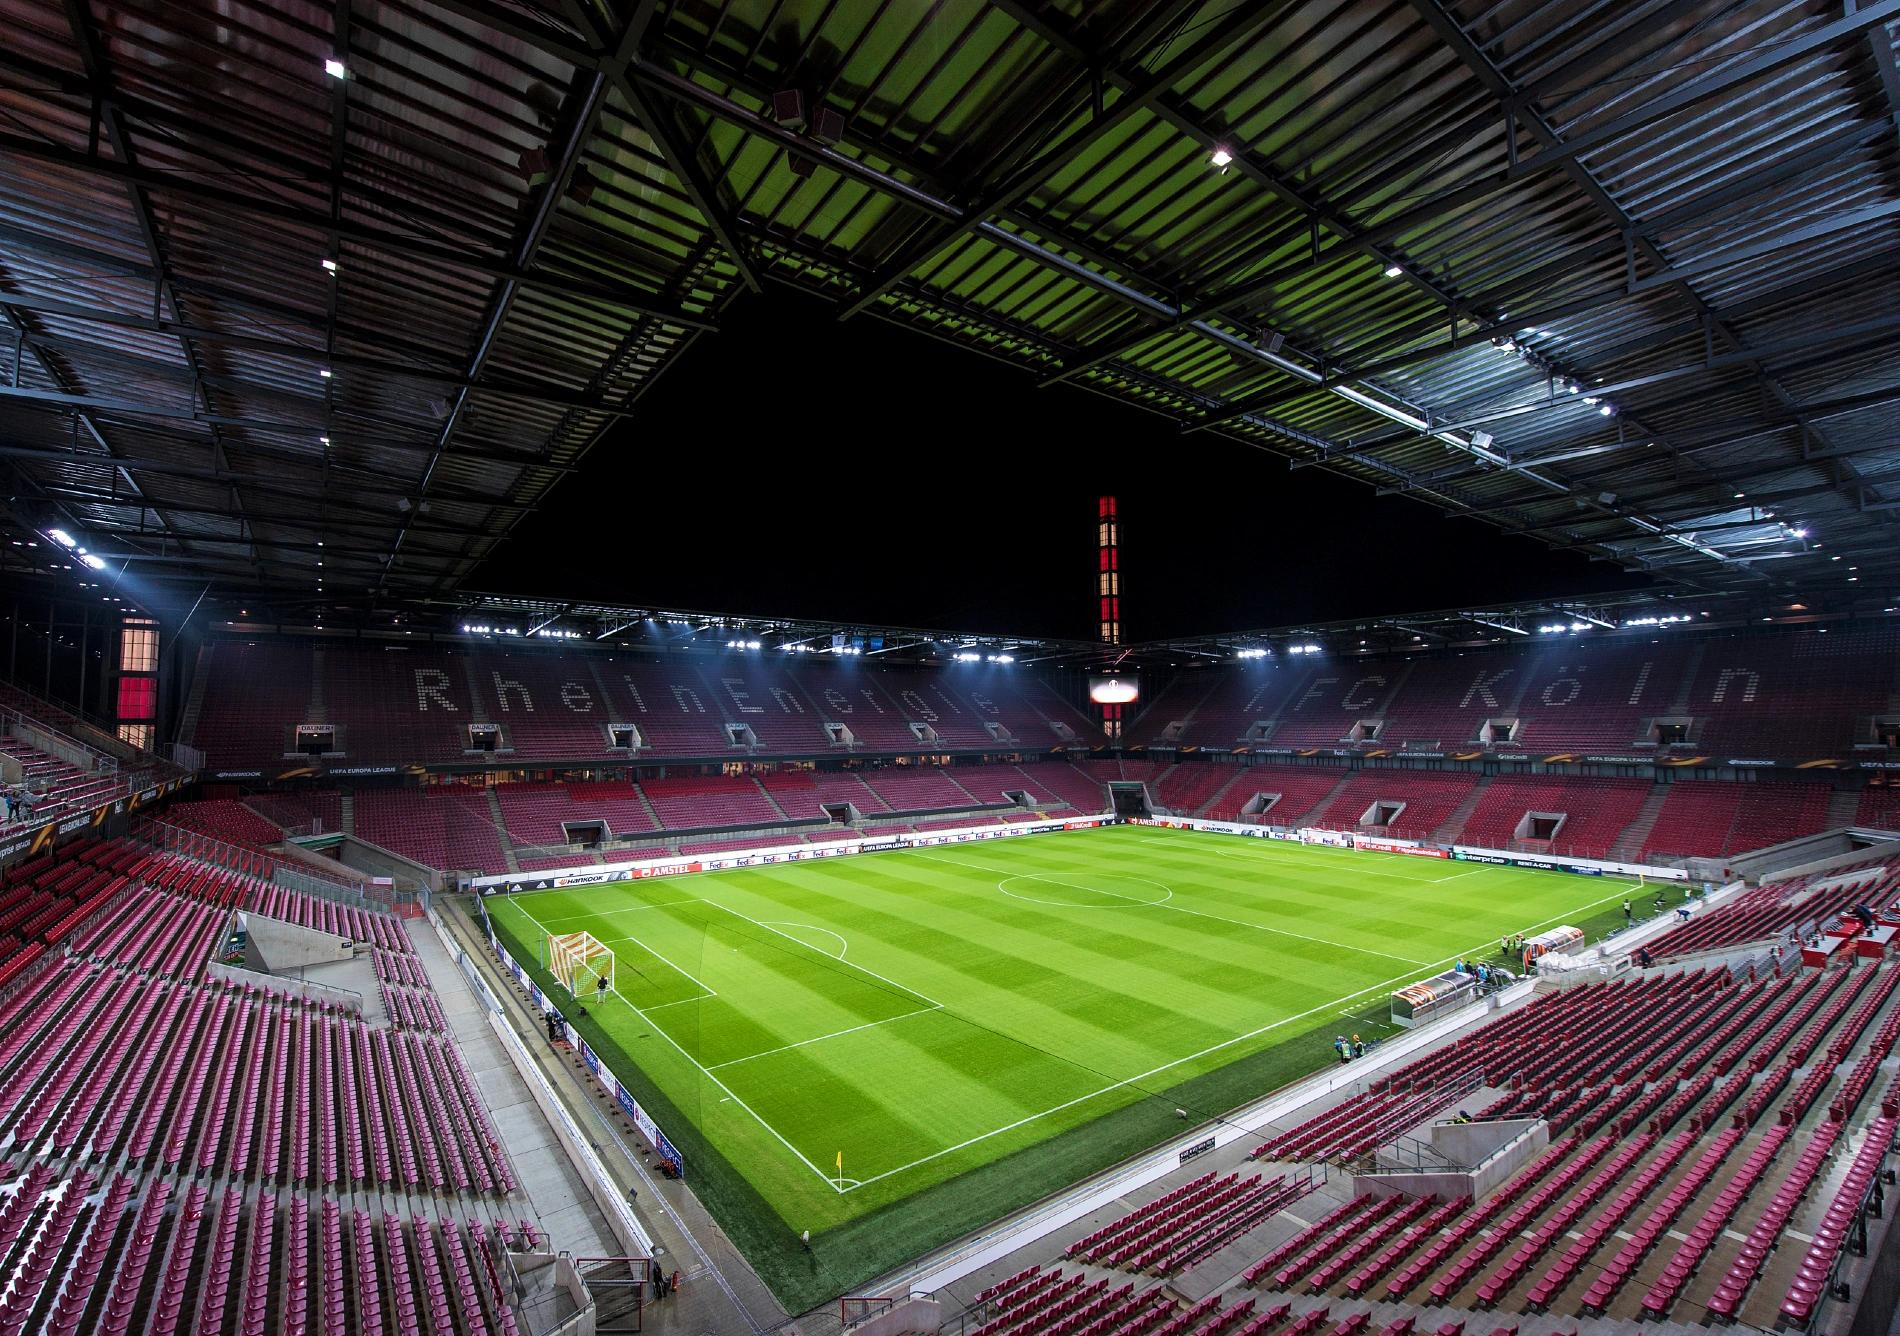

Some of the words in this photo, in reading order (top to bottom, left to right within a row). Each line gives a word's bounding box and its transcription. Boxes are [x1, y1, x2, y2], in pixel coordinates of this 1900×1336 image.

[1294, 675, 1386, 712] FC
[1459, 662, 1761, 708] Köln
[1138, 818, 1162, 827] AMSTEL
[1365, 843, 1392, 851] UniCredit
[737, 858, 756, 866] FedEx
[763, 855, 781, 864] FedEx
[1458, 853, 1505, 864] enterprise
[1517, 861, 1552, 869] RENT-A-CAR
[709, 861, 728, 869] FedEx
[653, 865, 689, 876] AMSTEL
